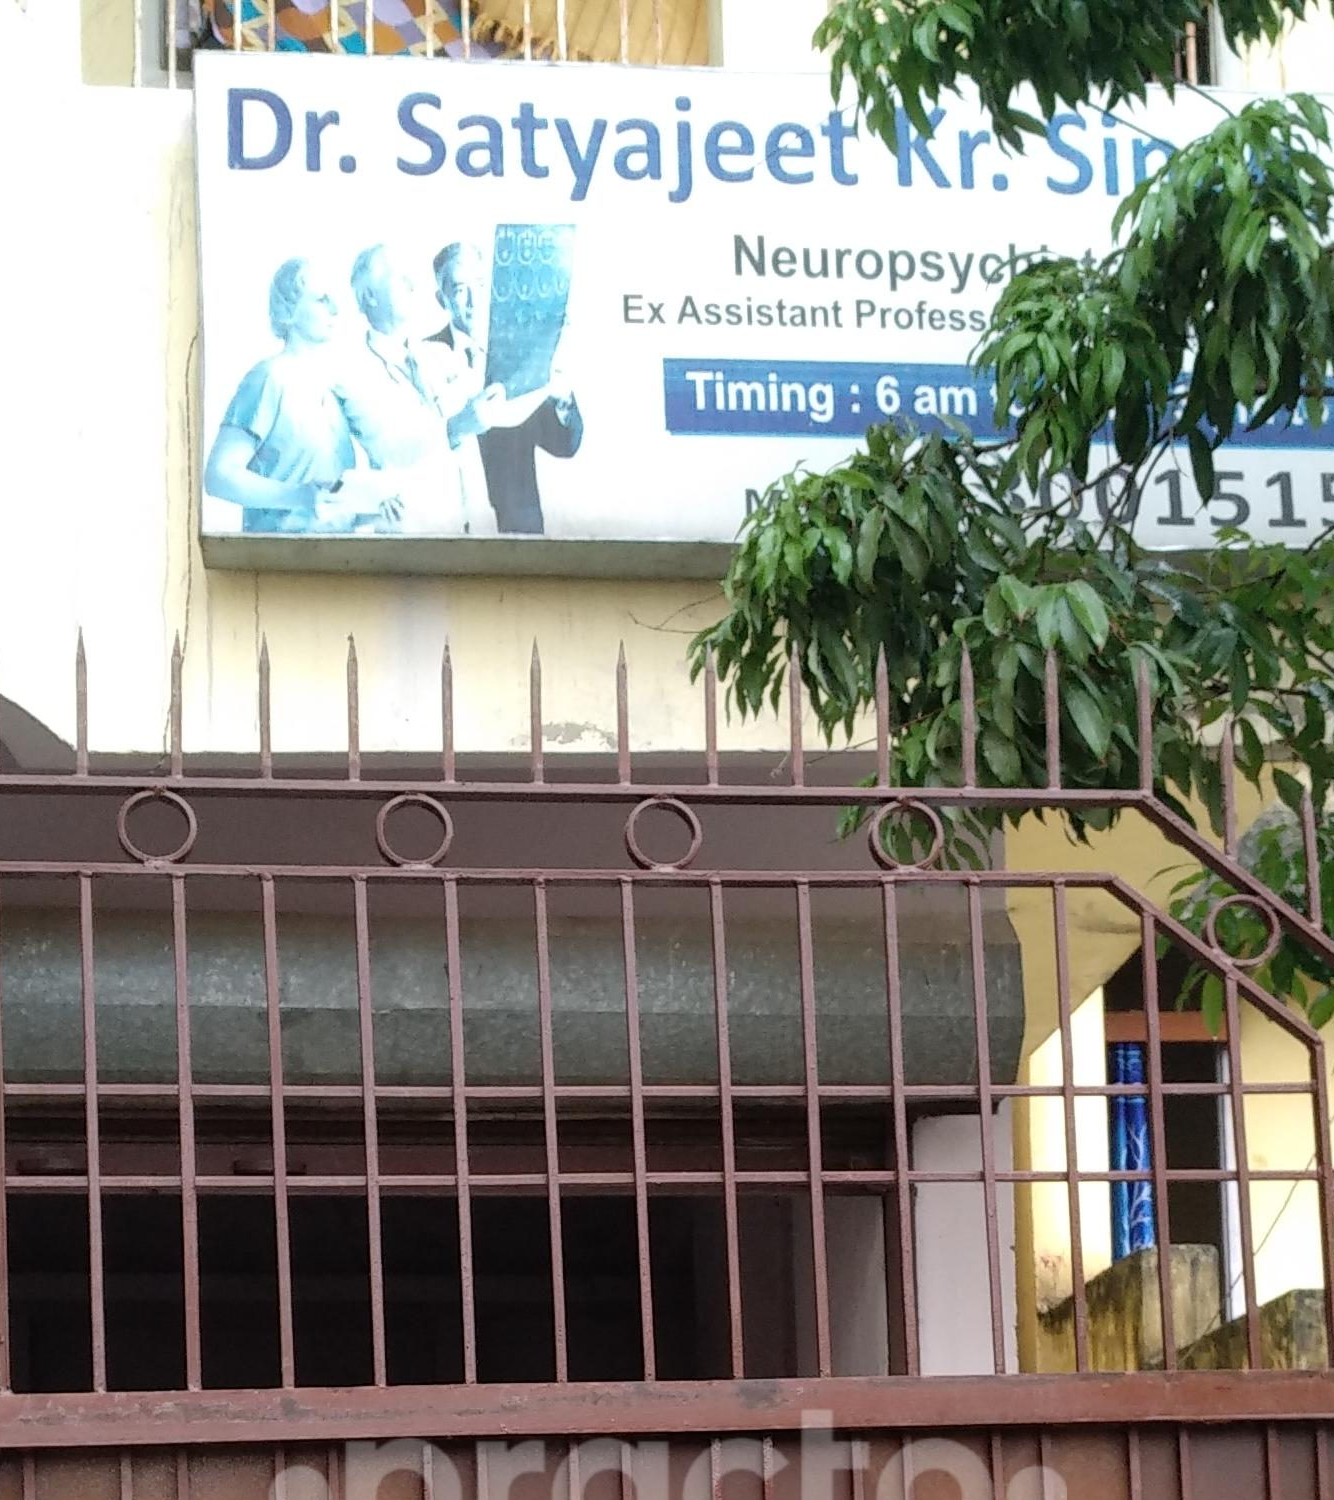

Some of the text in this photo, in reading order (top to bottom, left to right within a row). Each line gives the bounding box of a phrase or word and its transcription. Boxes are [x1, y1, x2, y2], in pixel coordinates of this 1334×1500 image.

[226, 87, 357, 175] Dr.
[396, 91, 859, 204] Satyajeet
[894, 105, 1010, 192] Kr.
[622, 293, 999, 333] Ex Assistant Profess
[685, 370, 835, 424] Timing
[850, 383, 862, 414] :
[874, 374, 902, 416] 6
[912, 384, 979, 416] am
